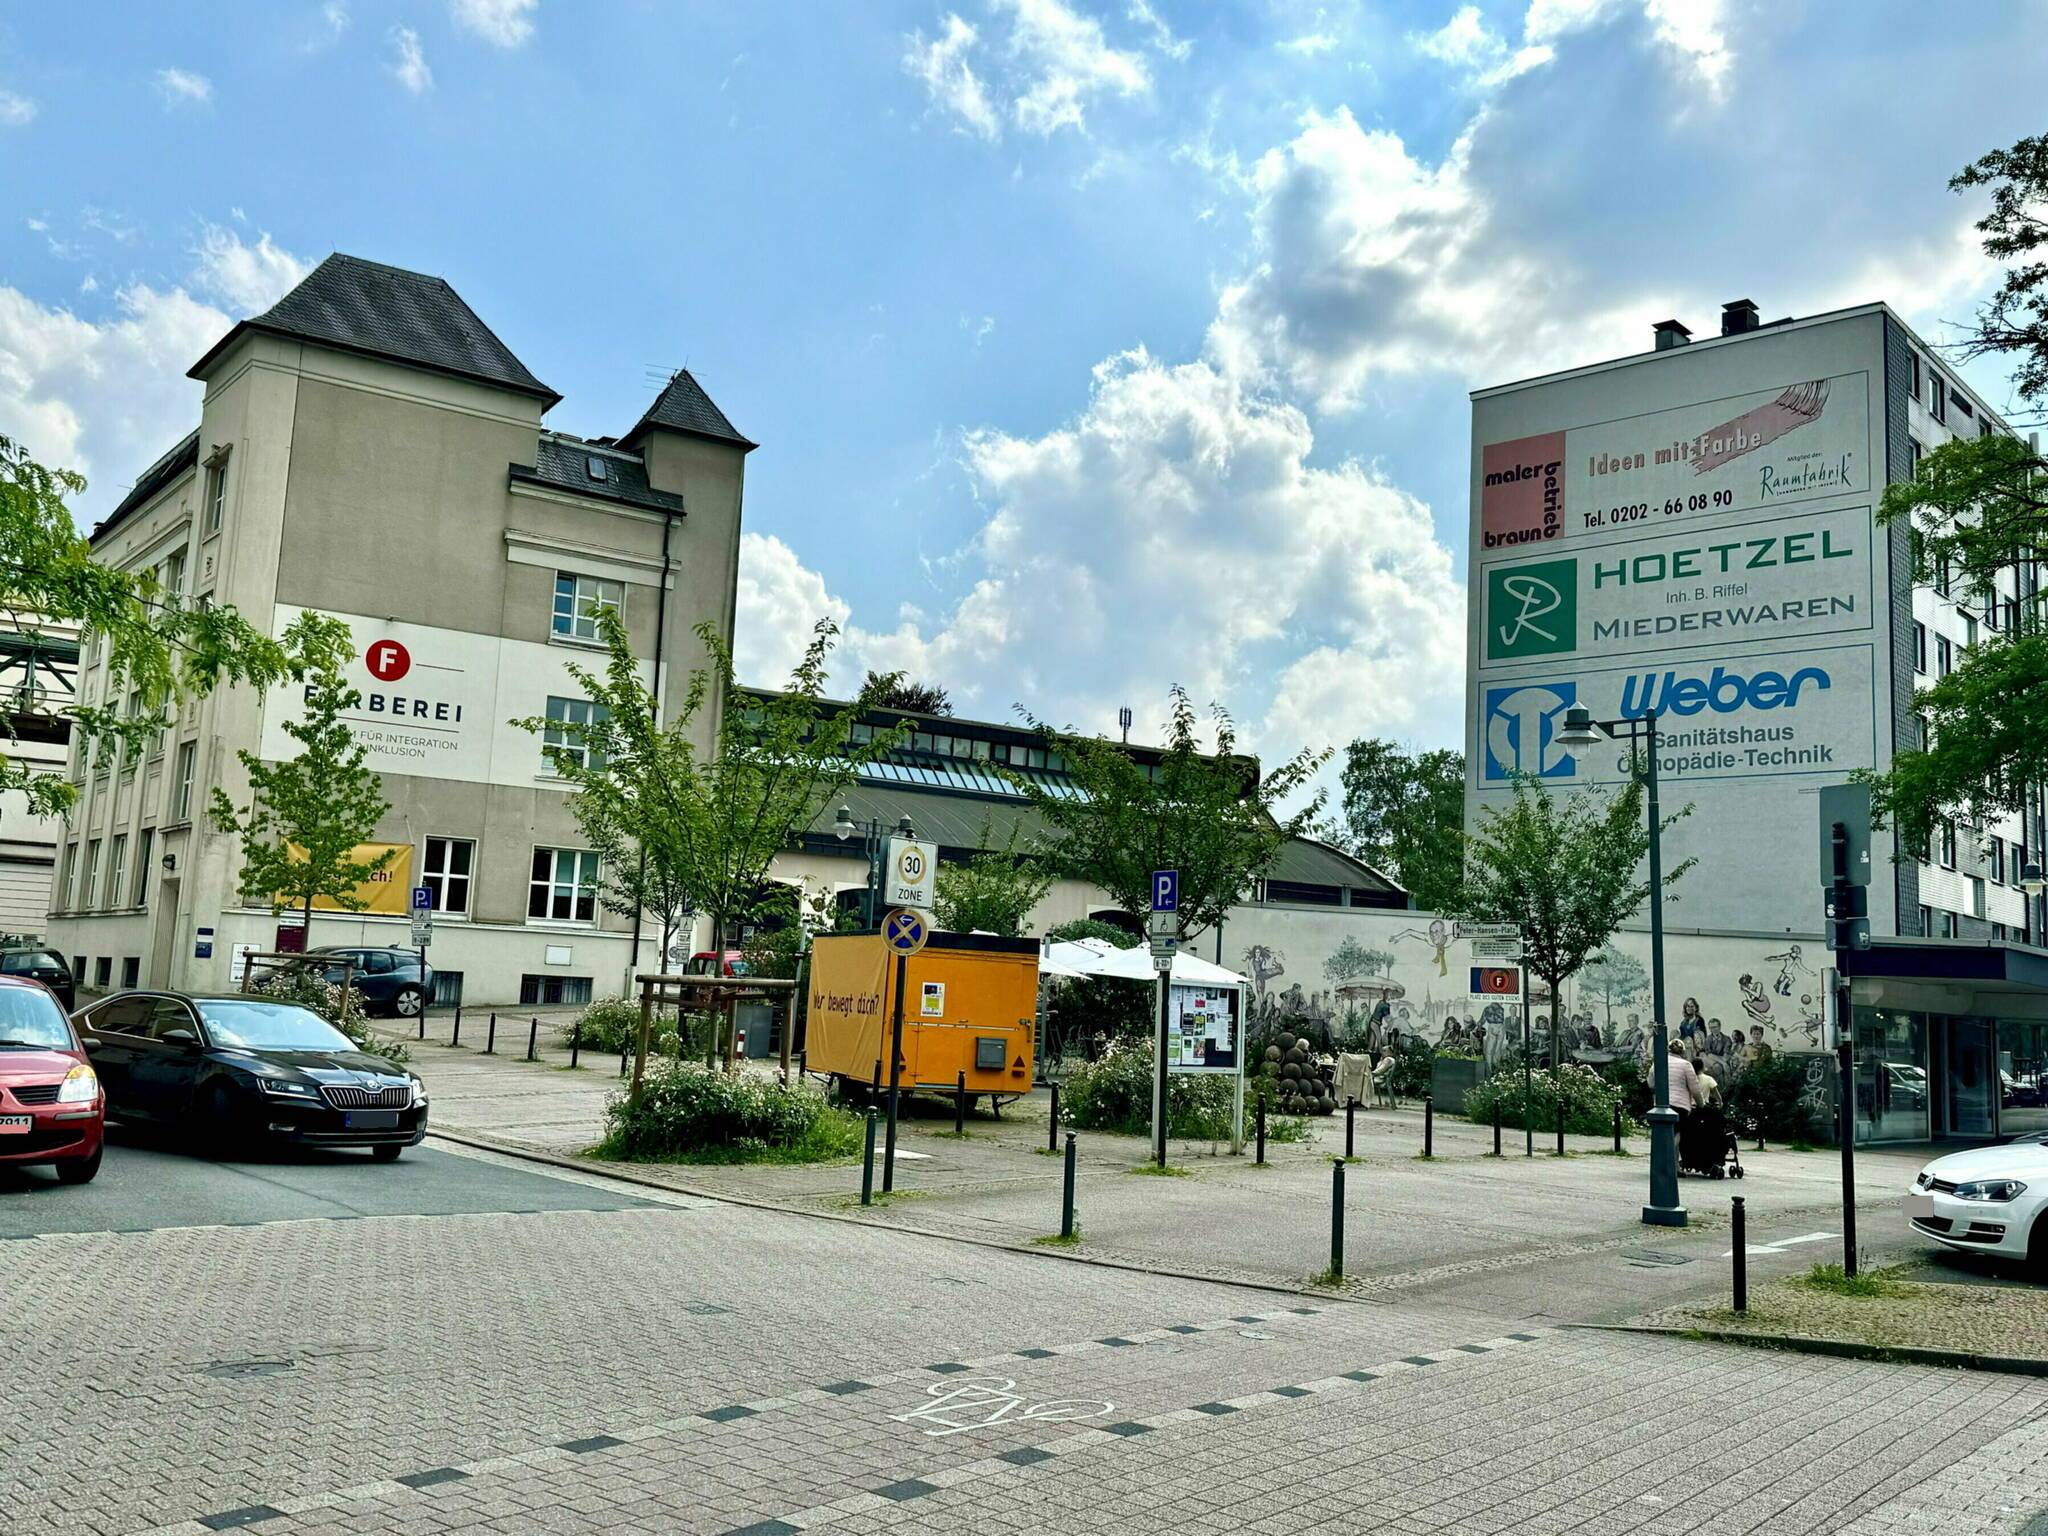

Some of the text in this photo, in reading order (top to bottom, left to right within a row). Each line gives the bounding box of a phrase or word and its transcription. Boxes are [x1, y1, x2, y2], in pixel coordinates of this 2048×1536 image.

[1589, 428, 1762, 477] Ideen mit Farbe
[1485, 464, 1543, 487] maler
[1760, 454, 1852, 500] Raumfabrik
[1543, 461, 1562, 538] betrieb
[1584, 510, 1606, 528] Tel.
[1610, 503, 1648, 524] 0202
[1664, 497, 1683, 515] 66
[1688, 494, 1707, 512] 08
[1713, 489, 1732, 507] 90
[1484, 528, 1542, 548] braun
[1594, 530, 1853, 590] HOETZEL
[1666, 583, 1748, 604] Inh. B. Riffel
[1593, 595, 1855, 641] MIEDERWAREN
[379, 647, 398, 673] F
[304, 685, 462, 723] FRBEREI
[1620, 667, 1831, 720] Weber
[346, 741, 426, 758] ND INKLUSION
[360, 730, 383, 742] FÜR
[386, 734, 458, 750] INTEGRATION
[1655, 725, 1794, 749] Sanitätshaus
[1617, 745, 1833, 775] Ohopädie-Technik
[905, 856, 920, 874] 30
[415, 890, 426, 907] P
[898, 888, 923, 901] ZONE
[1158, 876, 1172, 906] P
[1460, 926, 1516, 935] Peter-Hansen-Platz
[1496, 977, 1503, 986] F
[828, 991, 853, 1018] bewegt
[857, 992, 880, 1015] dich?
